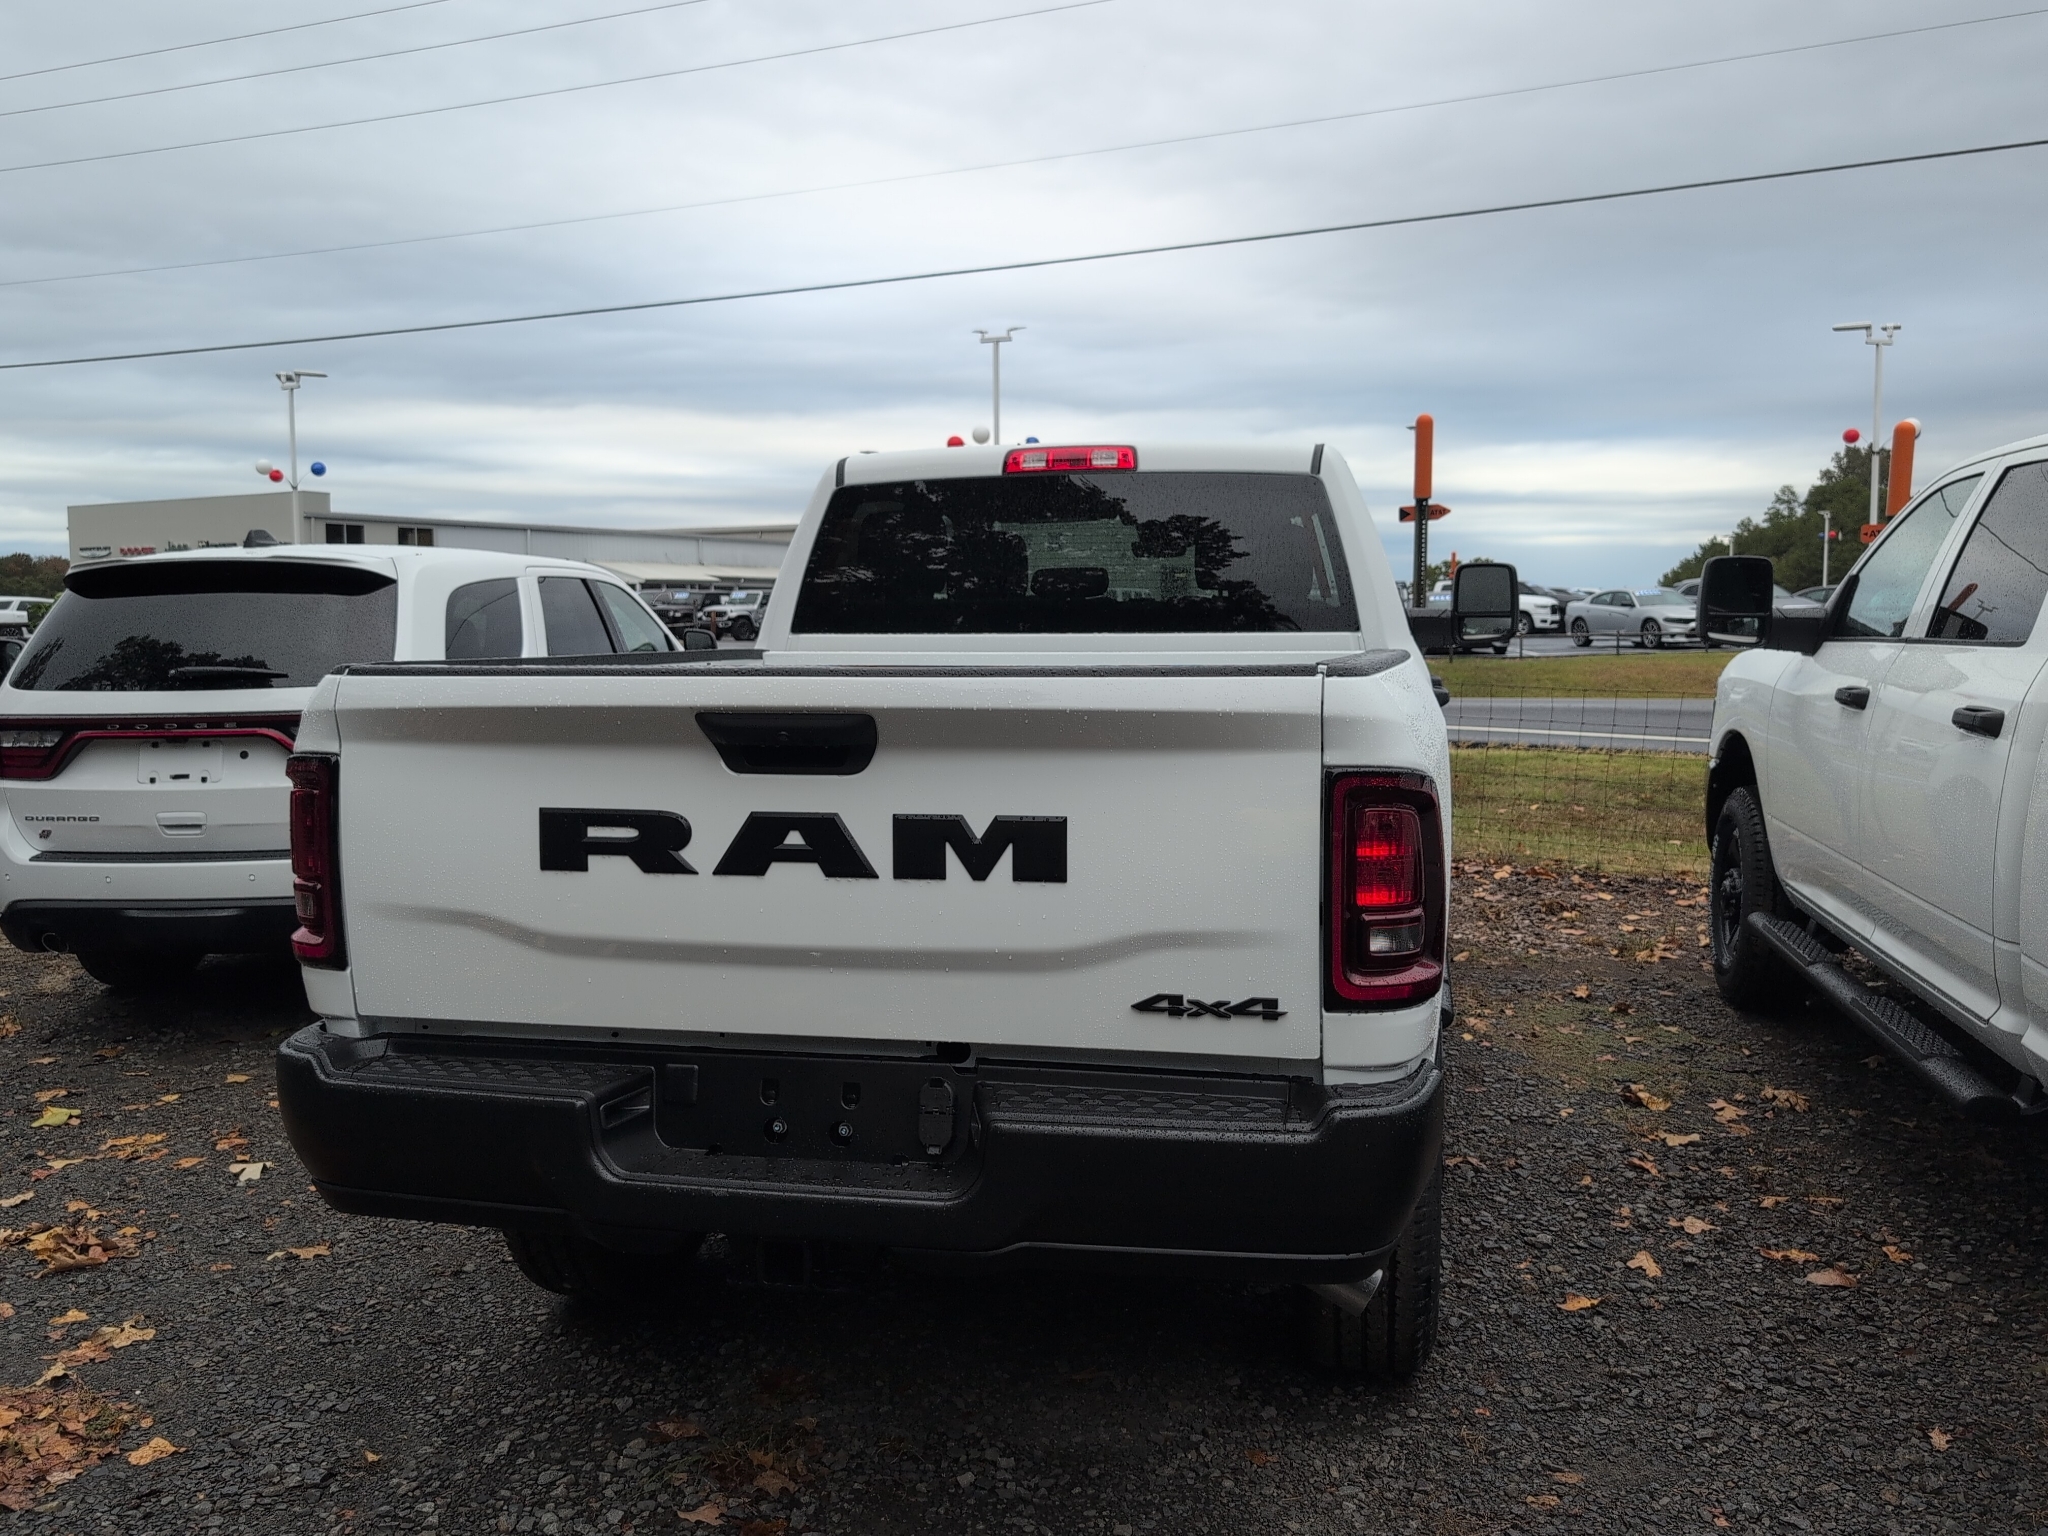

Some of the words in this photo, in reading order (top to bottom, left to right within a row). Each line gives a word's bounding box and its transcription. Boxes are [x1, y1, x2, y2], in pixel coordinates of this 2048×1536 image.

[107, 721, 238, 730] DODGE
[539, 806, 1068, 884] RAM
[1130, 993, 1289, 1021] 4x4
